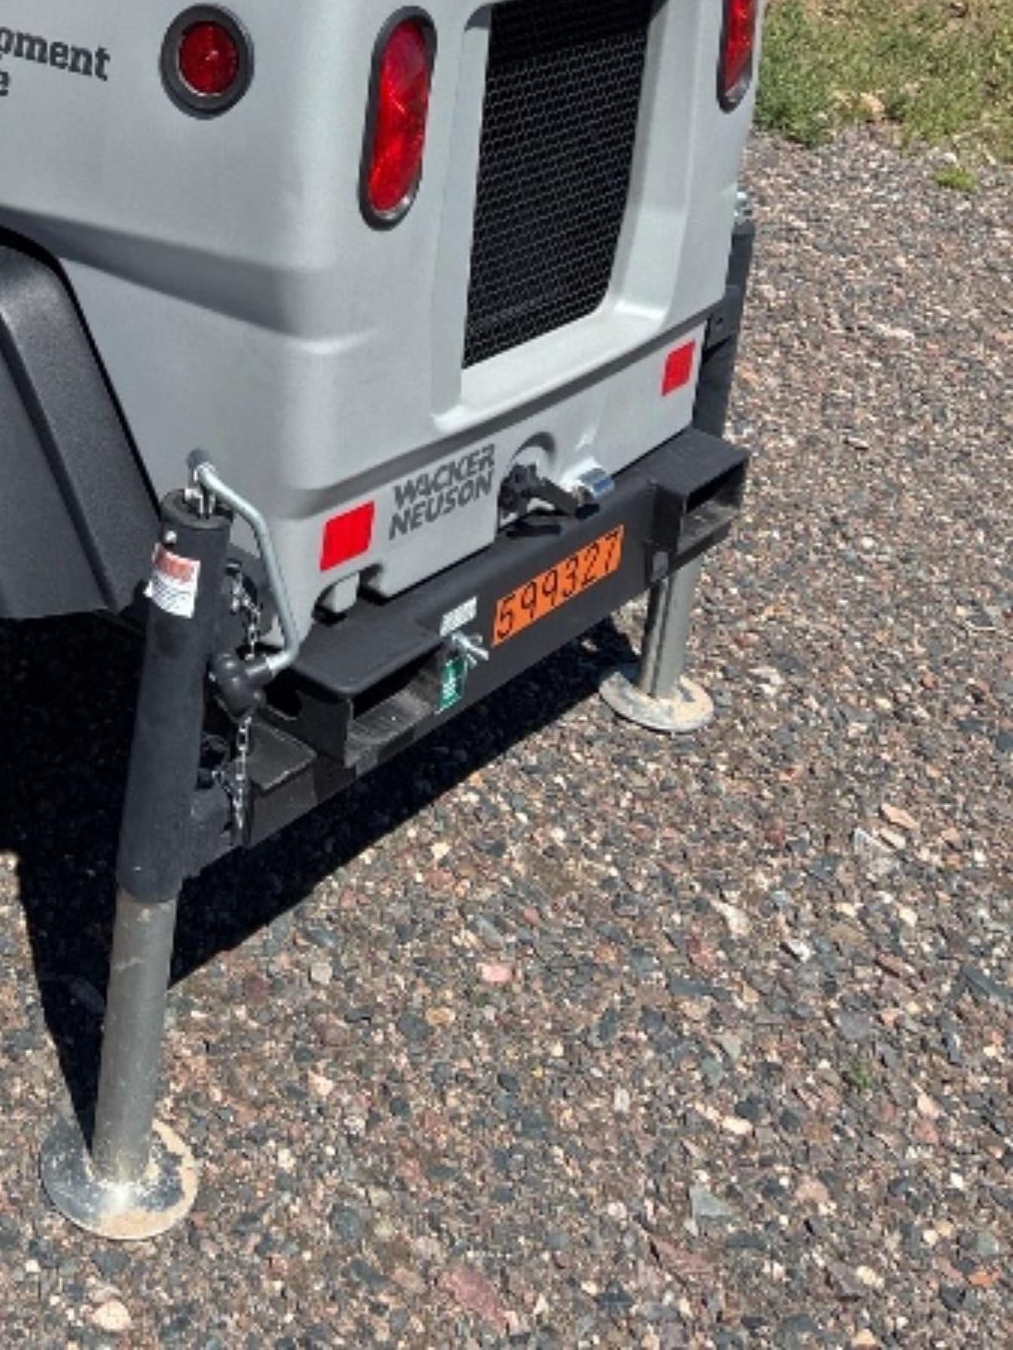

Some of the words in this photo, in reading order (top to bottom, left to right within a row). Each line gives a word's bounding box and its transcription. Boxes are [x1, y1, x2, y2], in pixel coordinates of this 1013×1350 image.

[389, 471, 494, 540] NEUSON
[392, 445, 496, 506] WACKER
[496, 534, 620, 637] 599327
